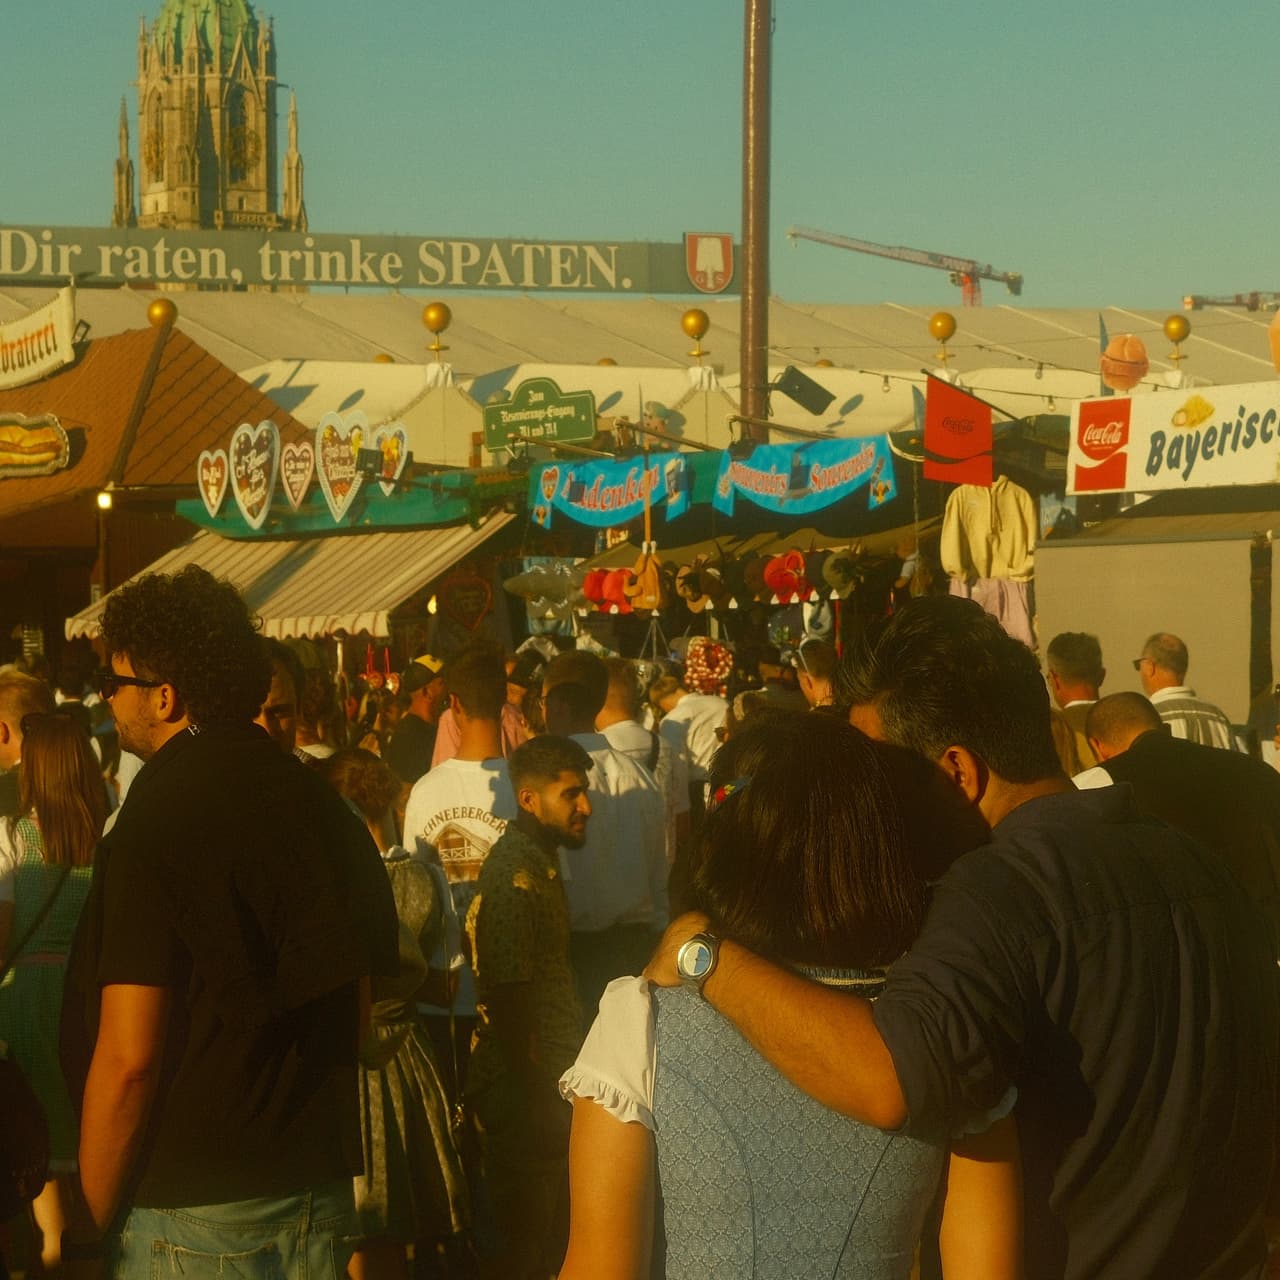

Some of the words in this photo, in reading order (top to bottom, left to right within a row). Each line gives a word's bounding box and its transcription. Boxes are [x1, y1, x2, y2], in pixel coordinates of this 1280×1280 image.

[97, 236, 243, 283] raten,
[259, 236, 403, 285] trinke
[418, 239, 633, 290] SPATEN.
[423, 806, 506, 840] CHNEEBERGER
